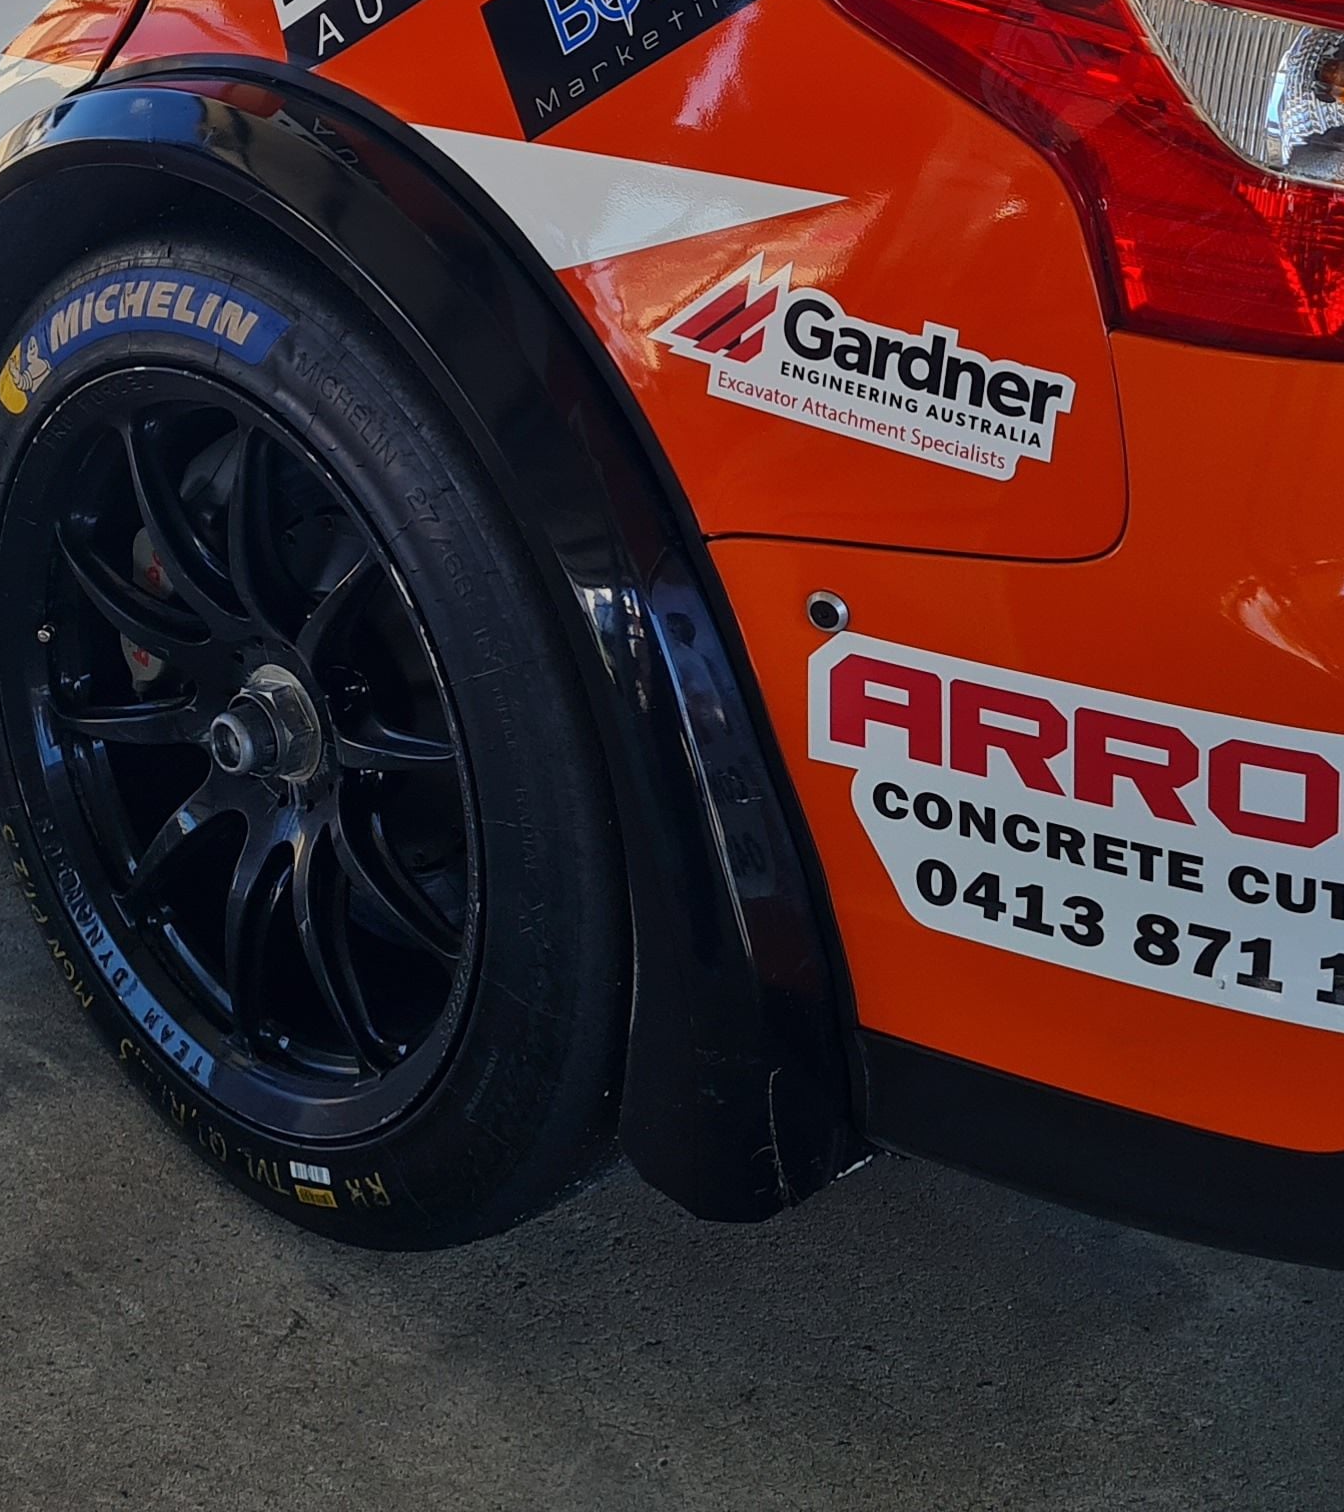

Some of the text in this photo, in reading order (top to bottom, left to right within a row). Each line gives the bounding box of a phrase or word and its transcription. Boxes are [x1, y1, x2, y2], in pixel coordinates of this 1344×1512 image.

[48, 279, 260, 355] MICHELIN
[782, 297, 1064, 427] Gardner
[716, 369, 1008, 472] Excavator Attachment Specialists
[779, 359, 1044, 450] ENGINEERING AUSTRALIA
[871, 780, 1205, 893] CONCRETE
[914, 856, 1107, 950] 0413
[1131, 911, 1285, 996] 871
[142, 1006, 206, 1079] TEAM
